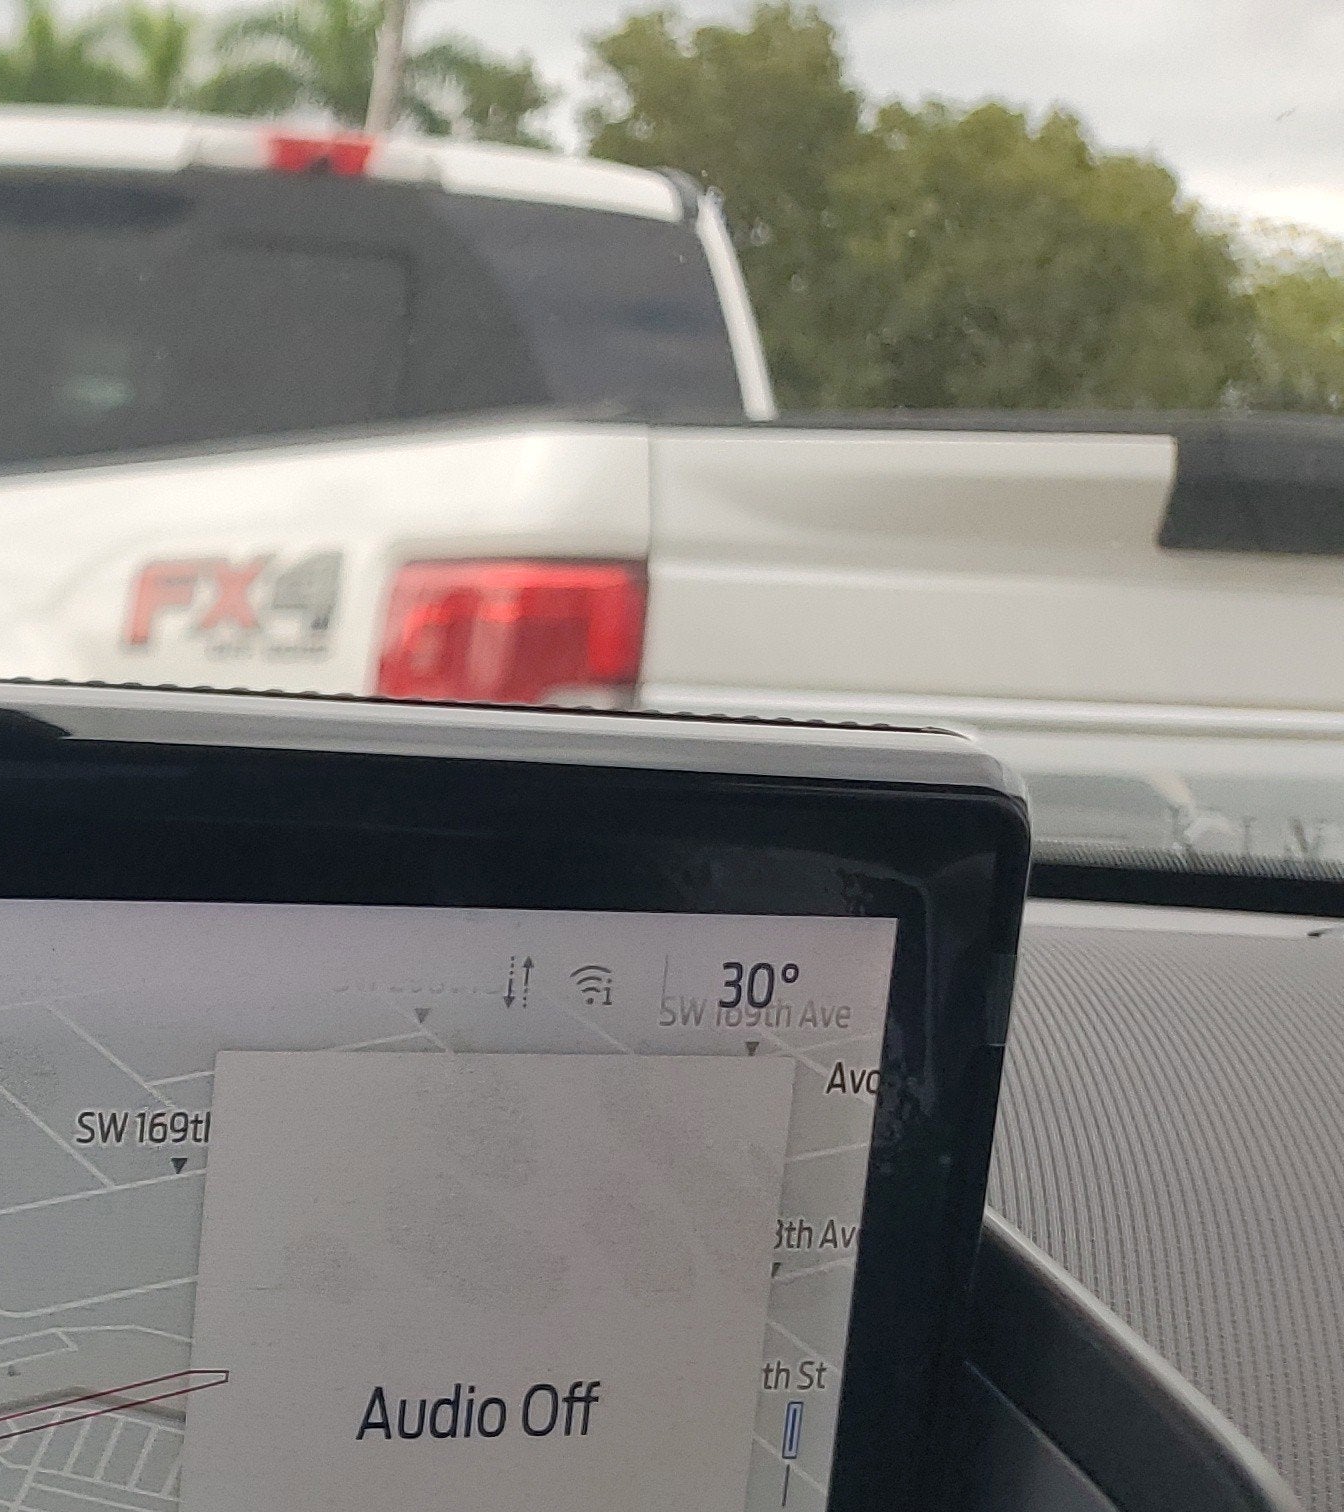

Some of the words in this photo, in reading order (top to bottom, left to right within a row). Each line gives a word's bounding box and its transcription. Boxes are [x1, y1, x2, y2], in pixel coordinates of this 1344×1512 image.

[116, 549, 342, 646] FX4
[719, 962, 800, 1009] 30°
[659, 1000, 703, 1027] SW
[798, 1001, 851, 1028] Ave
[76, 1111, 128, 1144] SW
[819, 1219, 860, 1249] Av
[797, 1361, 827, 1390] St
[356, 1385, 508, 1441] Audio
[521, 1380, 601, 1437] Off
